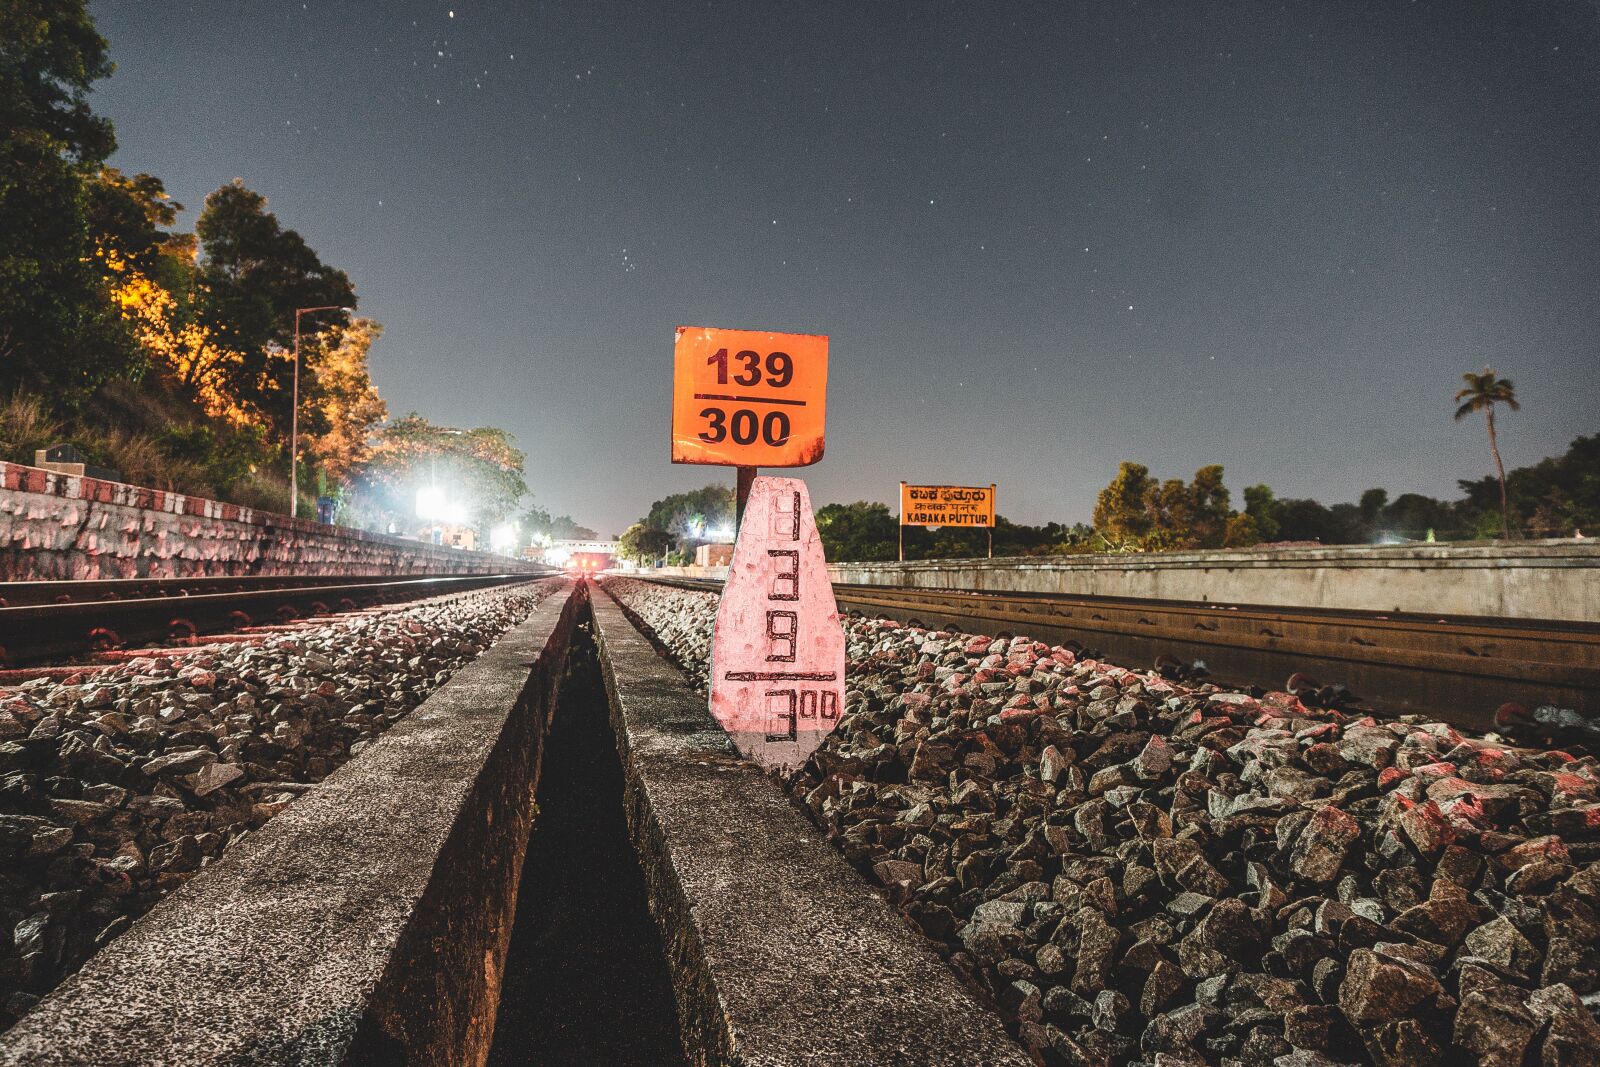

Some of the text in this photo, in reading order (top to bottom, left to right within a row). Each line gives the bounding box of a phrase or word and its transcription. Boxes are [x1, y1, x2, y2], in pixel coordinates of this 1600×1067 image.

[707, 348, 794, 388] 139
[697, 408, 791, 447] 300
[910, 489, 938, 500] ಕಬಕ
[907, 513, 988, 524] KABAKA PUTTUR
[765, 689, 838, 743] 300
